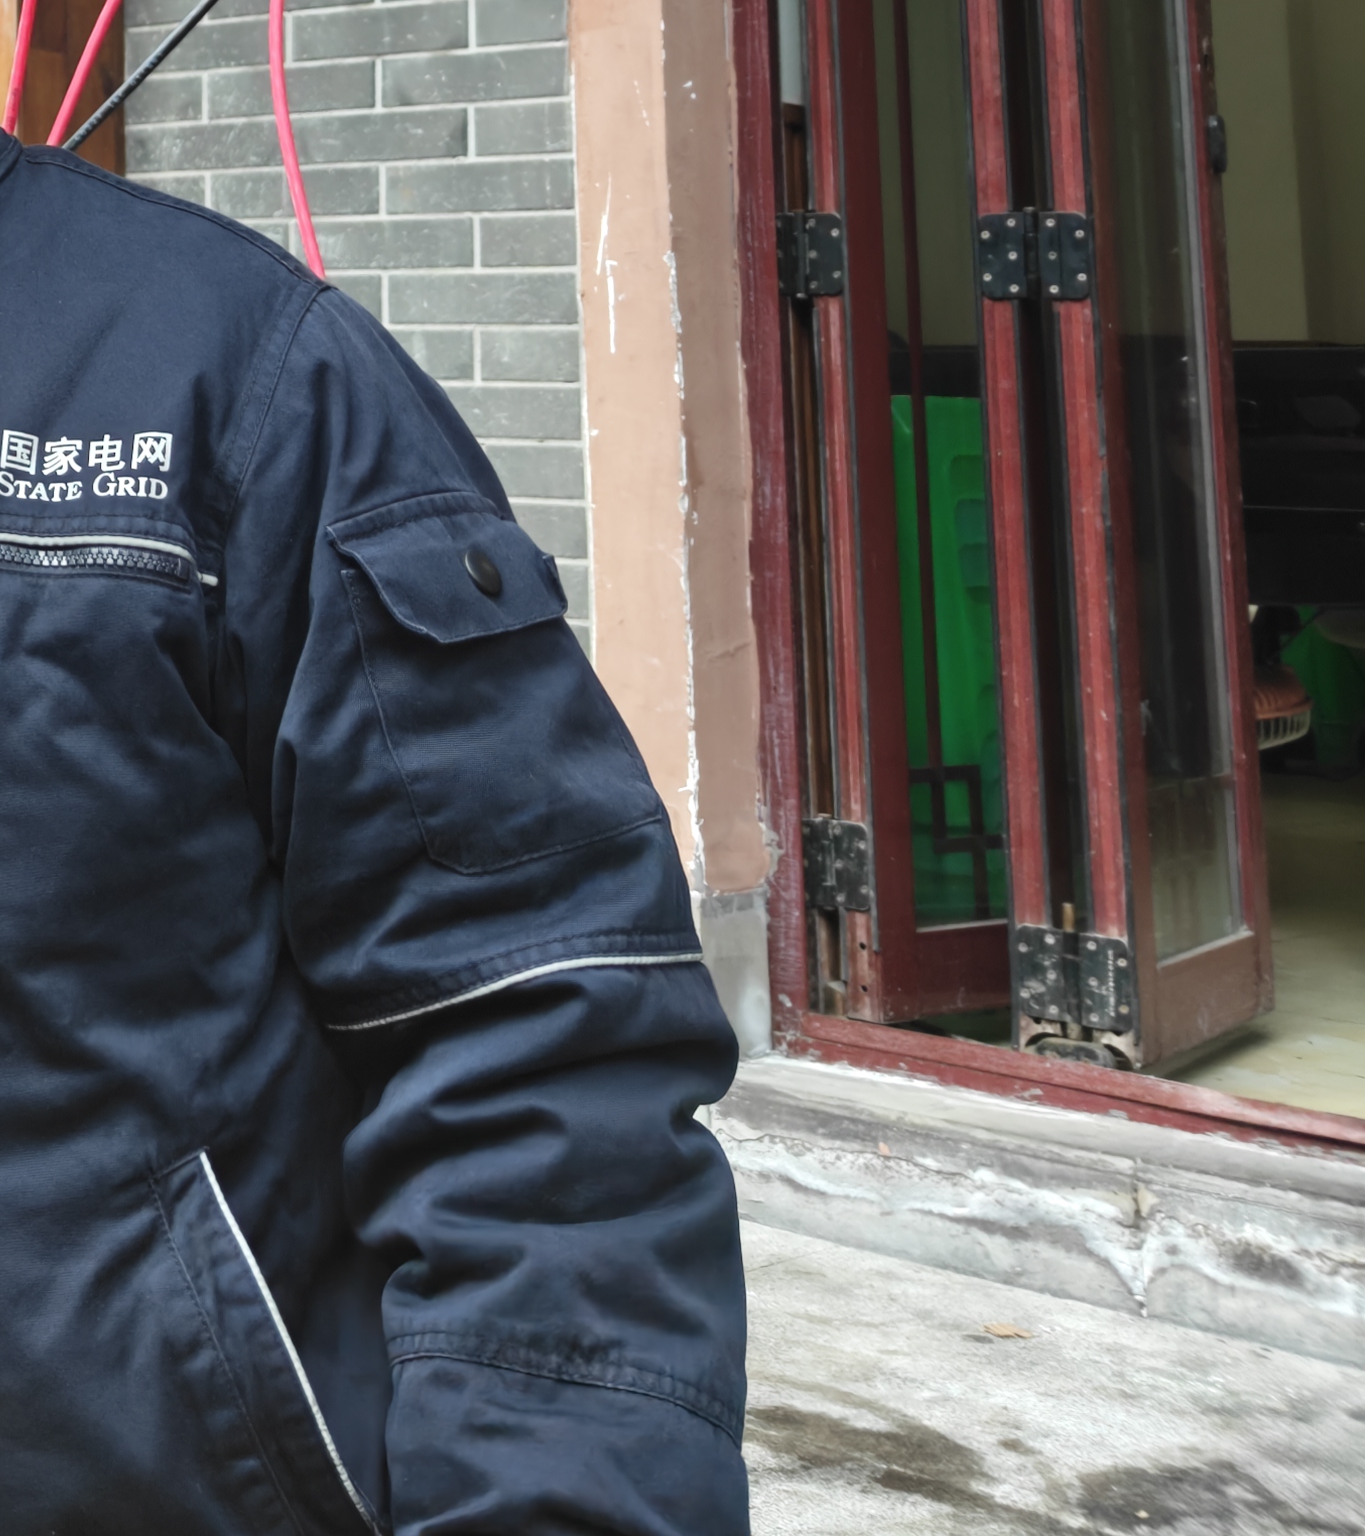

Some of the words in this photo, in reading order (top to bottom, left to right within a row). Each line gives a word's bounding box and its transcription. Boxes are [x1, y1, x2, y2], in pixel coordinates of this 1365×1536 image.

[0, 429, 173, 476] 国家电网
[92, 472, 168, 500] GRID
